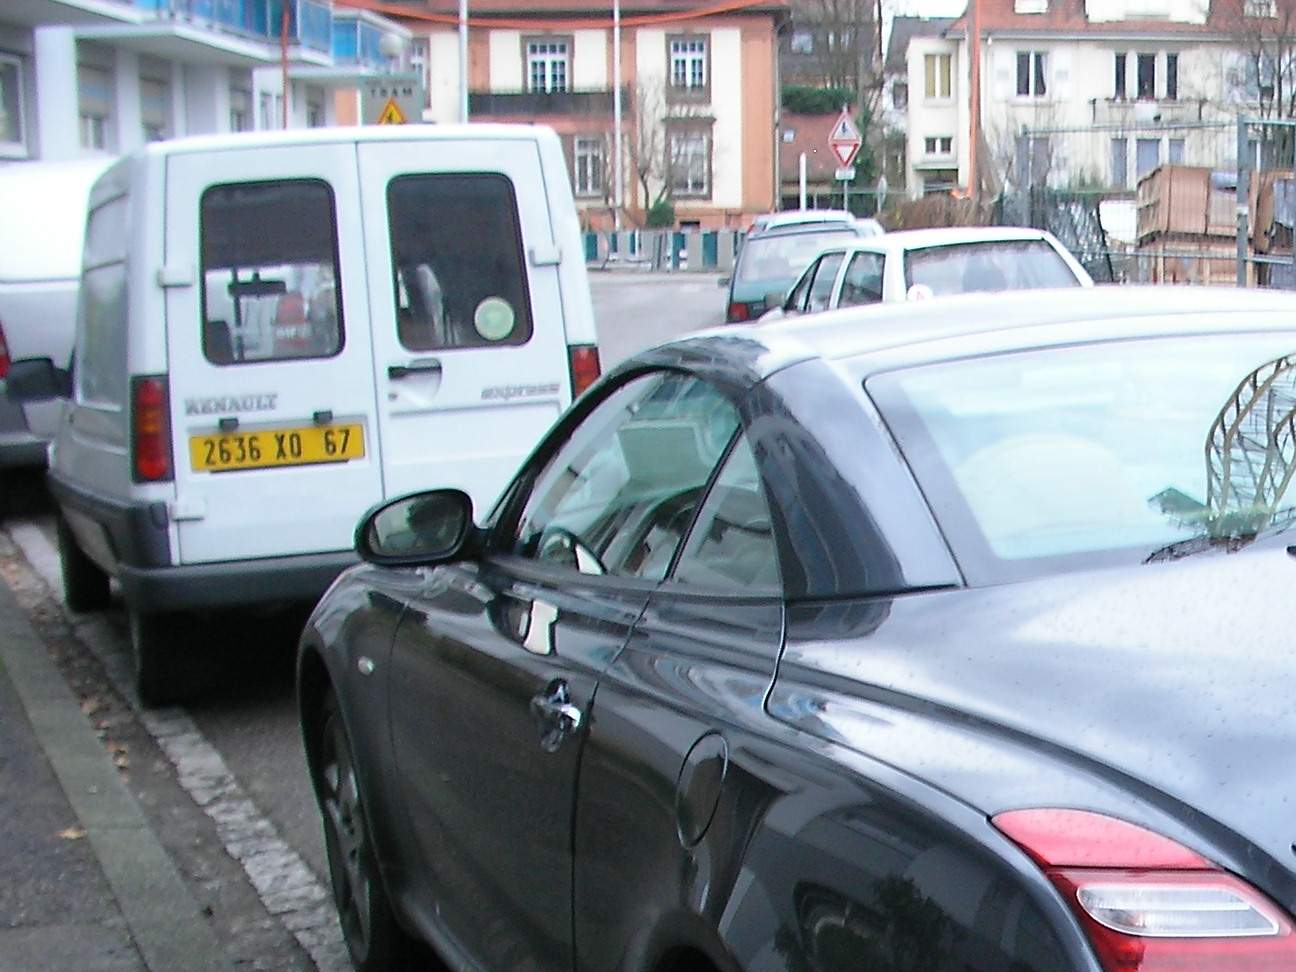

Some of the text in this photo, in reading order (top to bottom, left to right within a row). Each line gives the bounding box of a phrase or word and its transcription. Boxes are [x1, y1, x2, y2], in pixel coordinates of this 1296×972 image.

[183, 394, 279, 415] RENAULT
[204, 435, 261, 465] 2636
[324, 428, 350, 455] 67
